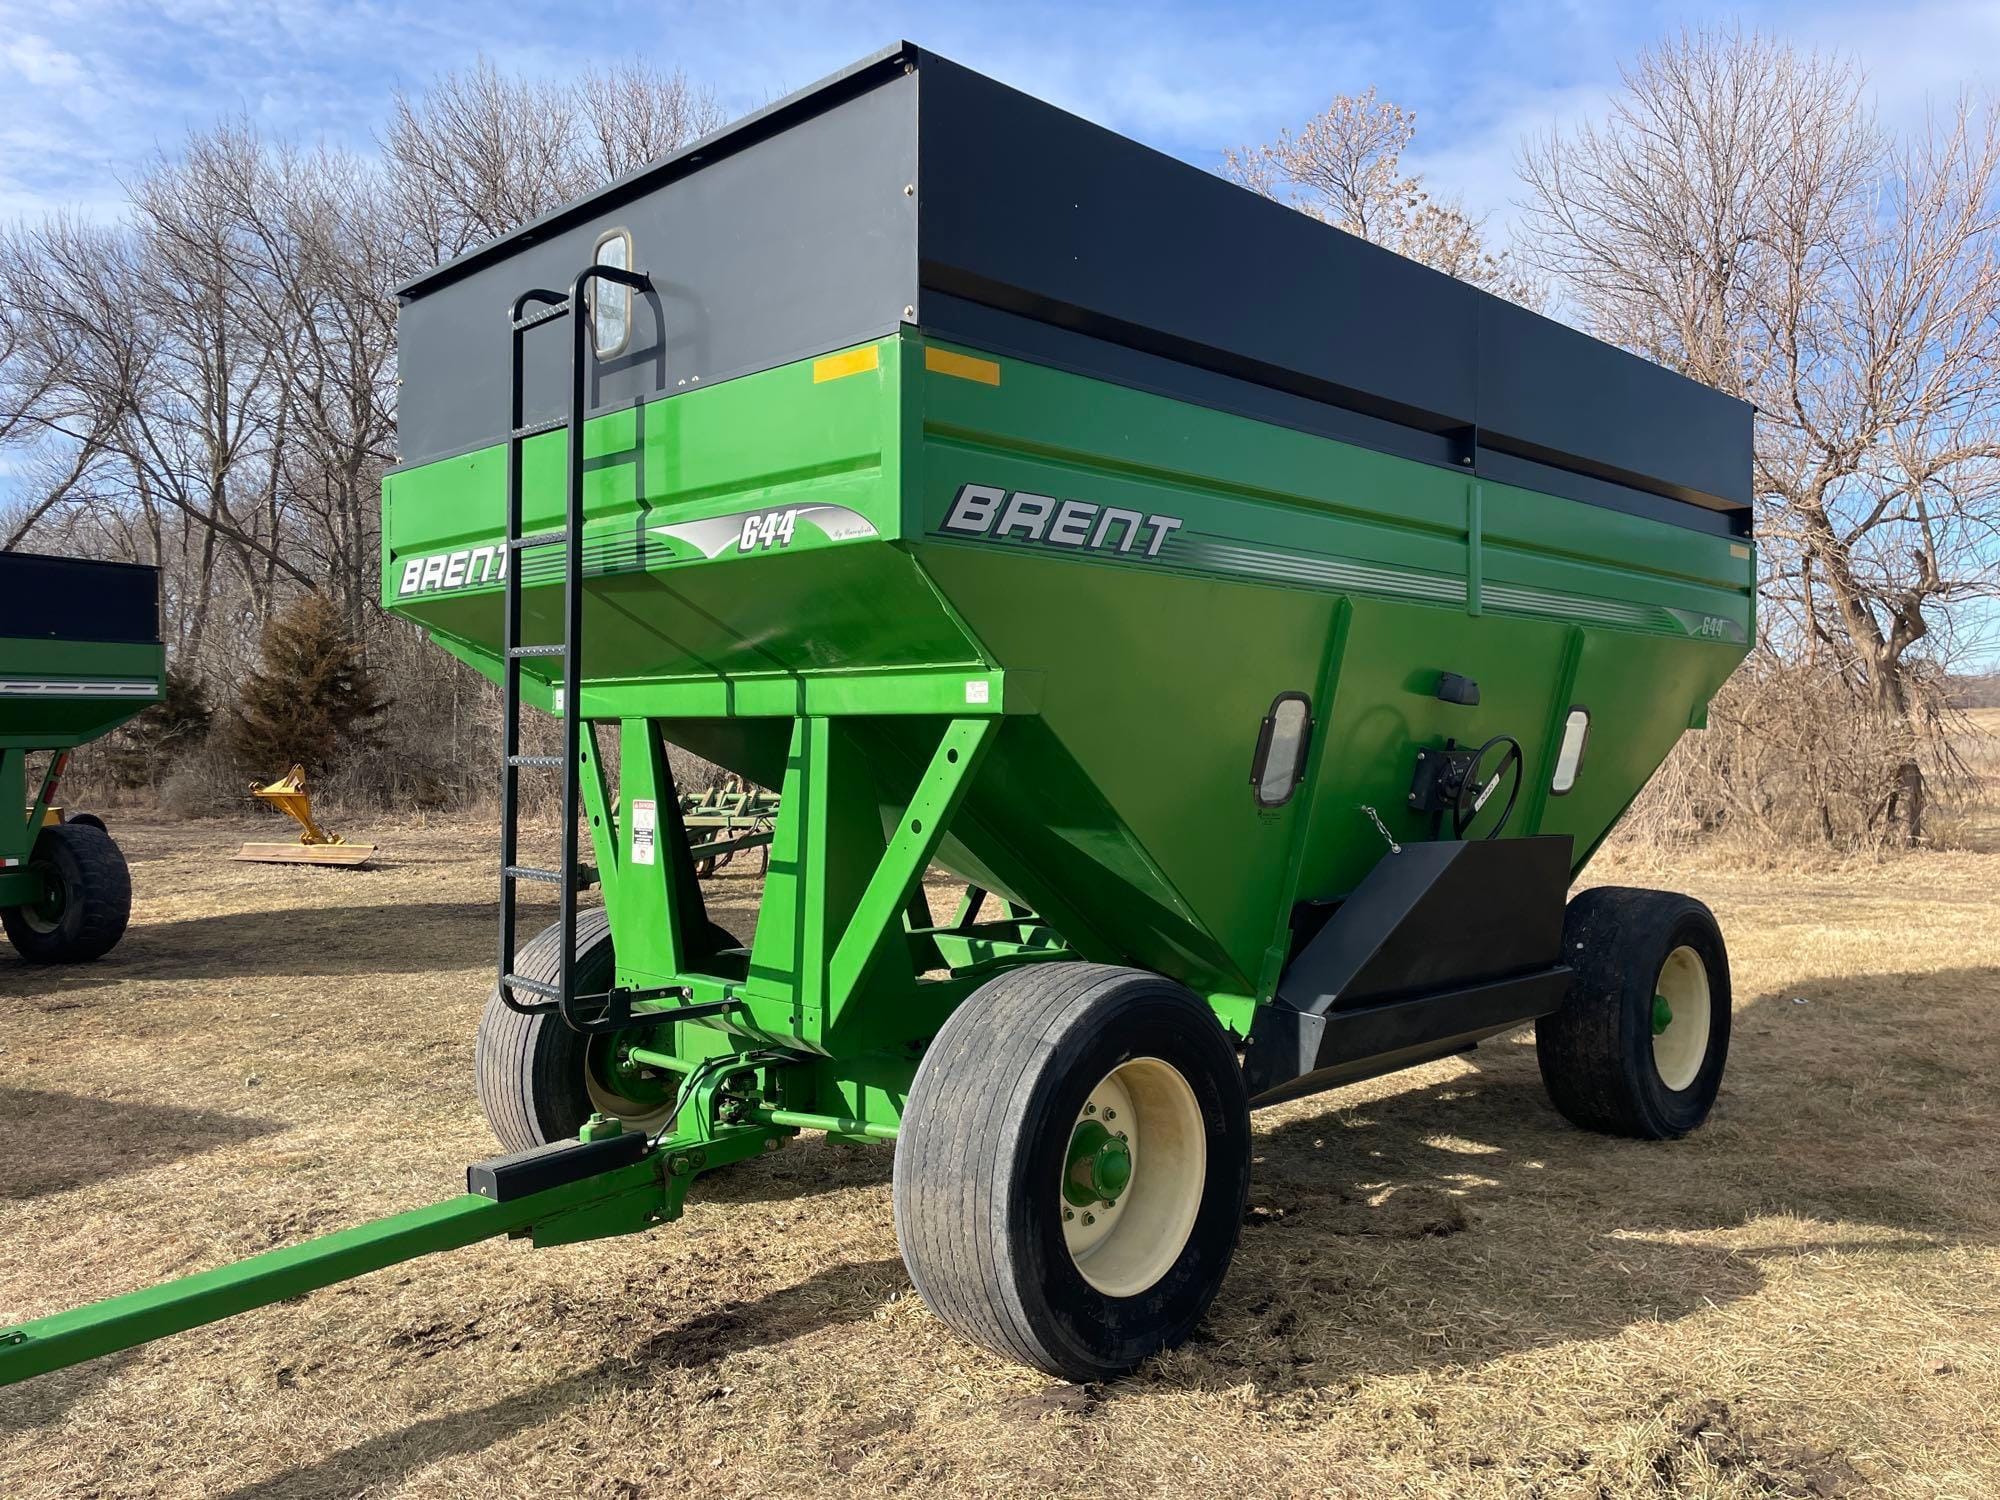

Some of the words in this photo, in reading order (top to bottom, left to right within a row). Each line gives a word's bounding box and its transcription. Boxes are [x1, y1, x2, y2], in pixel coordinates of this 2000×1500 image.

[738, 509, 797, 552] 644
[941, 482, 1183, 558] BRENT
[1702, 616, 1723, 637] 644
